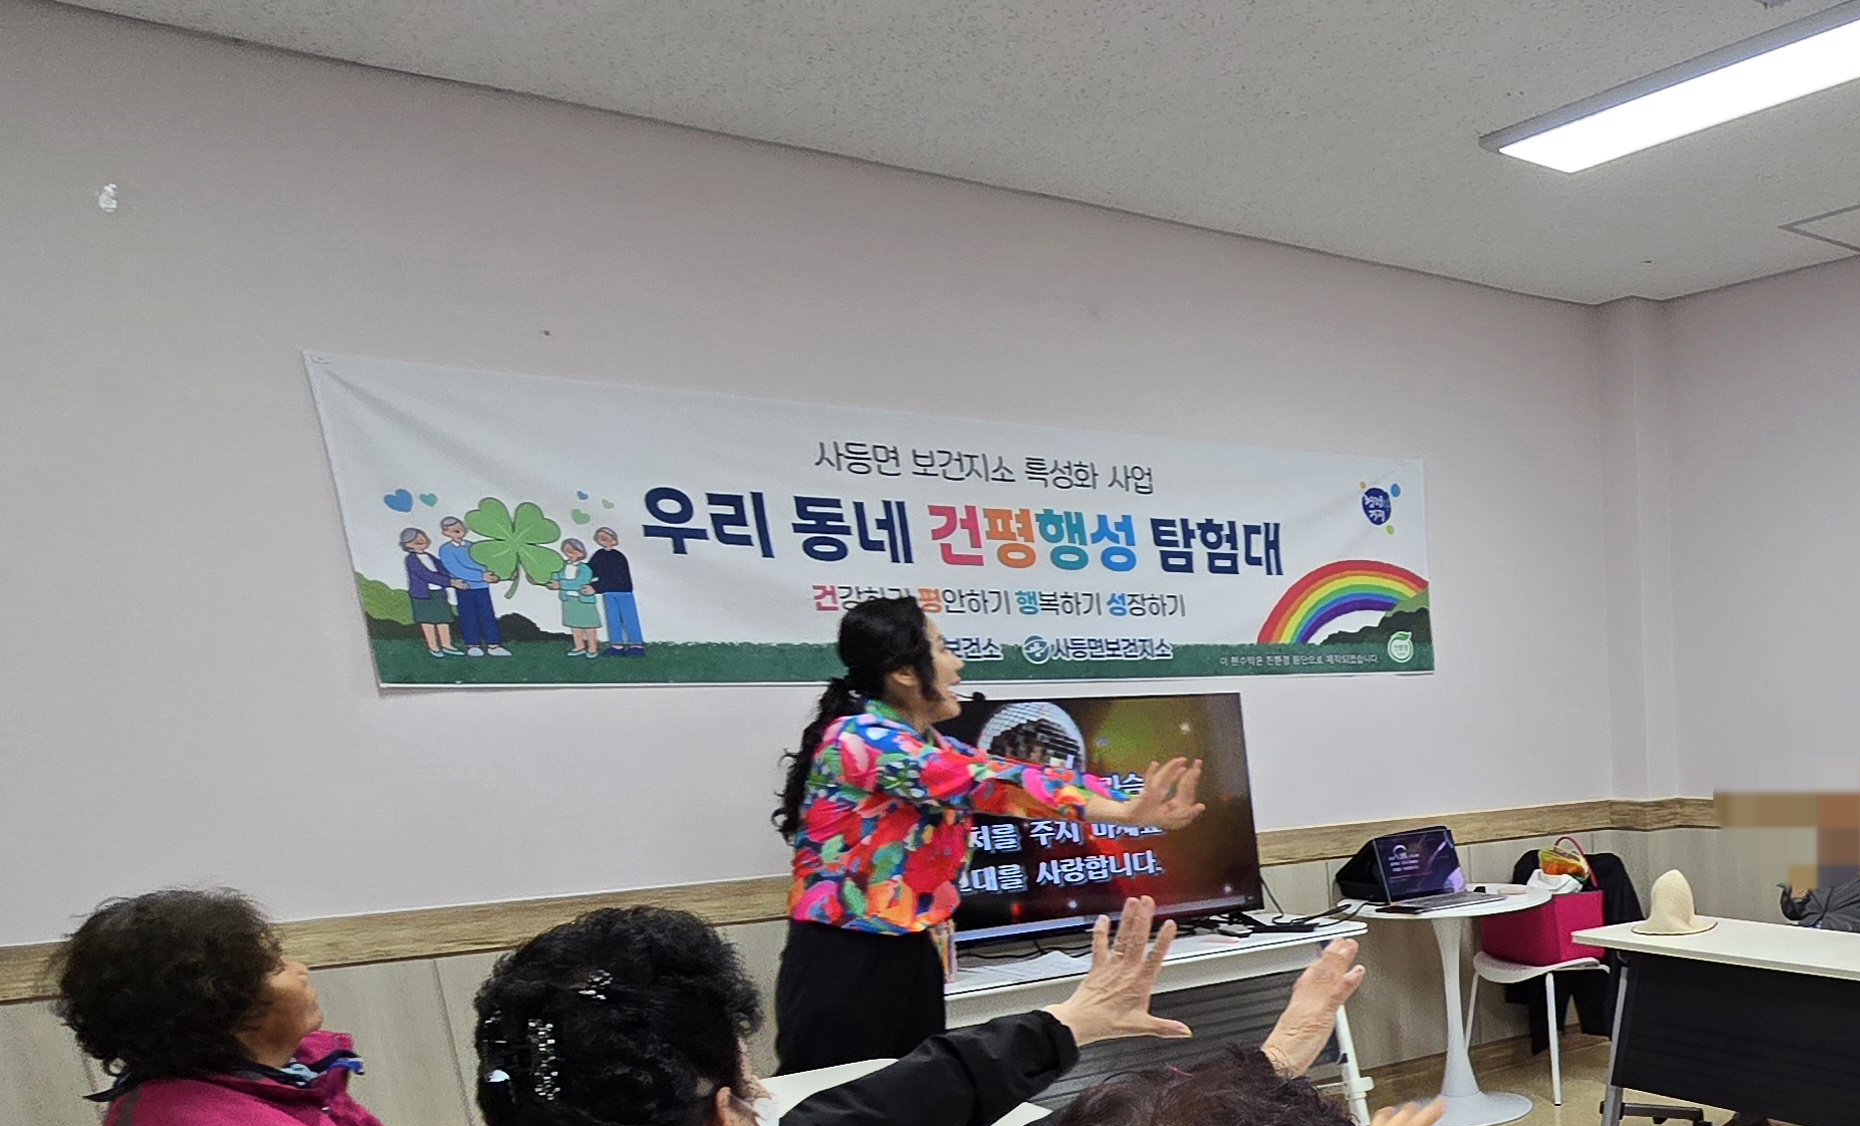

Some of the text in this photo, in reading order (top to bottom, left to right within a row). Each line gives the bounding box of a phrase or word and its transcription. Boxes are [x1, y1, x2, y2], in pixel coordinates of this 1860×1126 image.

[815, 441, 1154, 495] 사등면 보건지소 특성화 사업
[642, 486, 1284, 575] 우리 동네 건평행성 탐험대
[917, 587, 1011, 614] 평안하기
[1015, 590, 1102, 615] 행복하기
[1107, 592, 1186, 617] 성장하기
[1052, 637, 1173, 660] 사등면보건지소
[1029, 820, 1081, 846] 주지
[1036, 849, 1162, 885] 사랑합니다.
